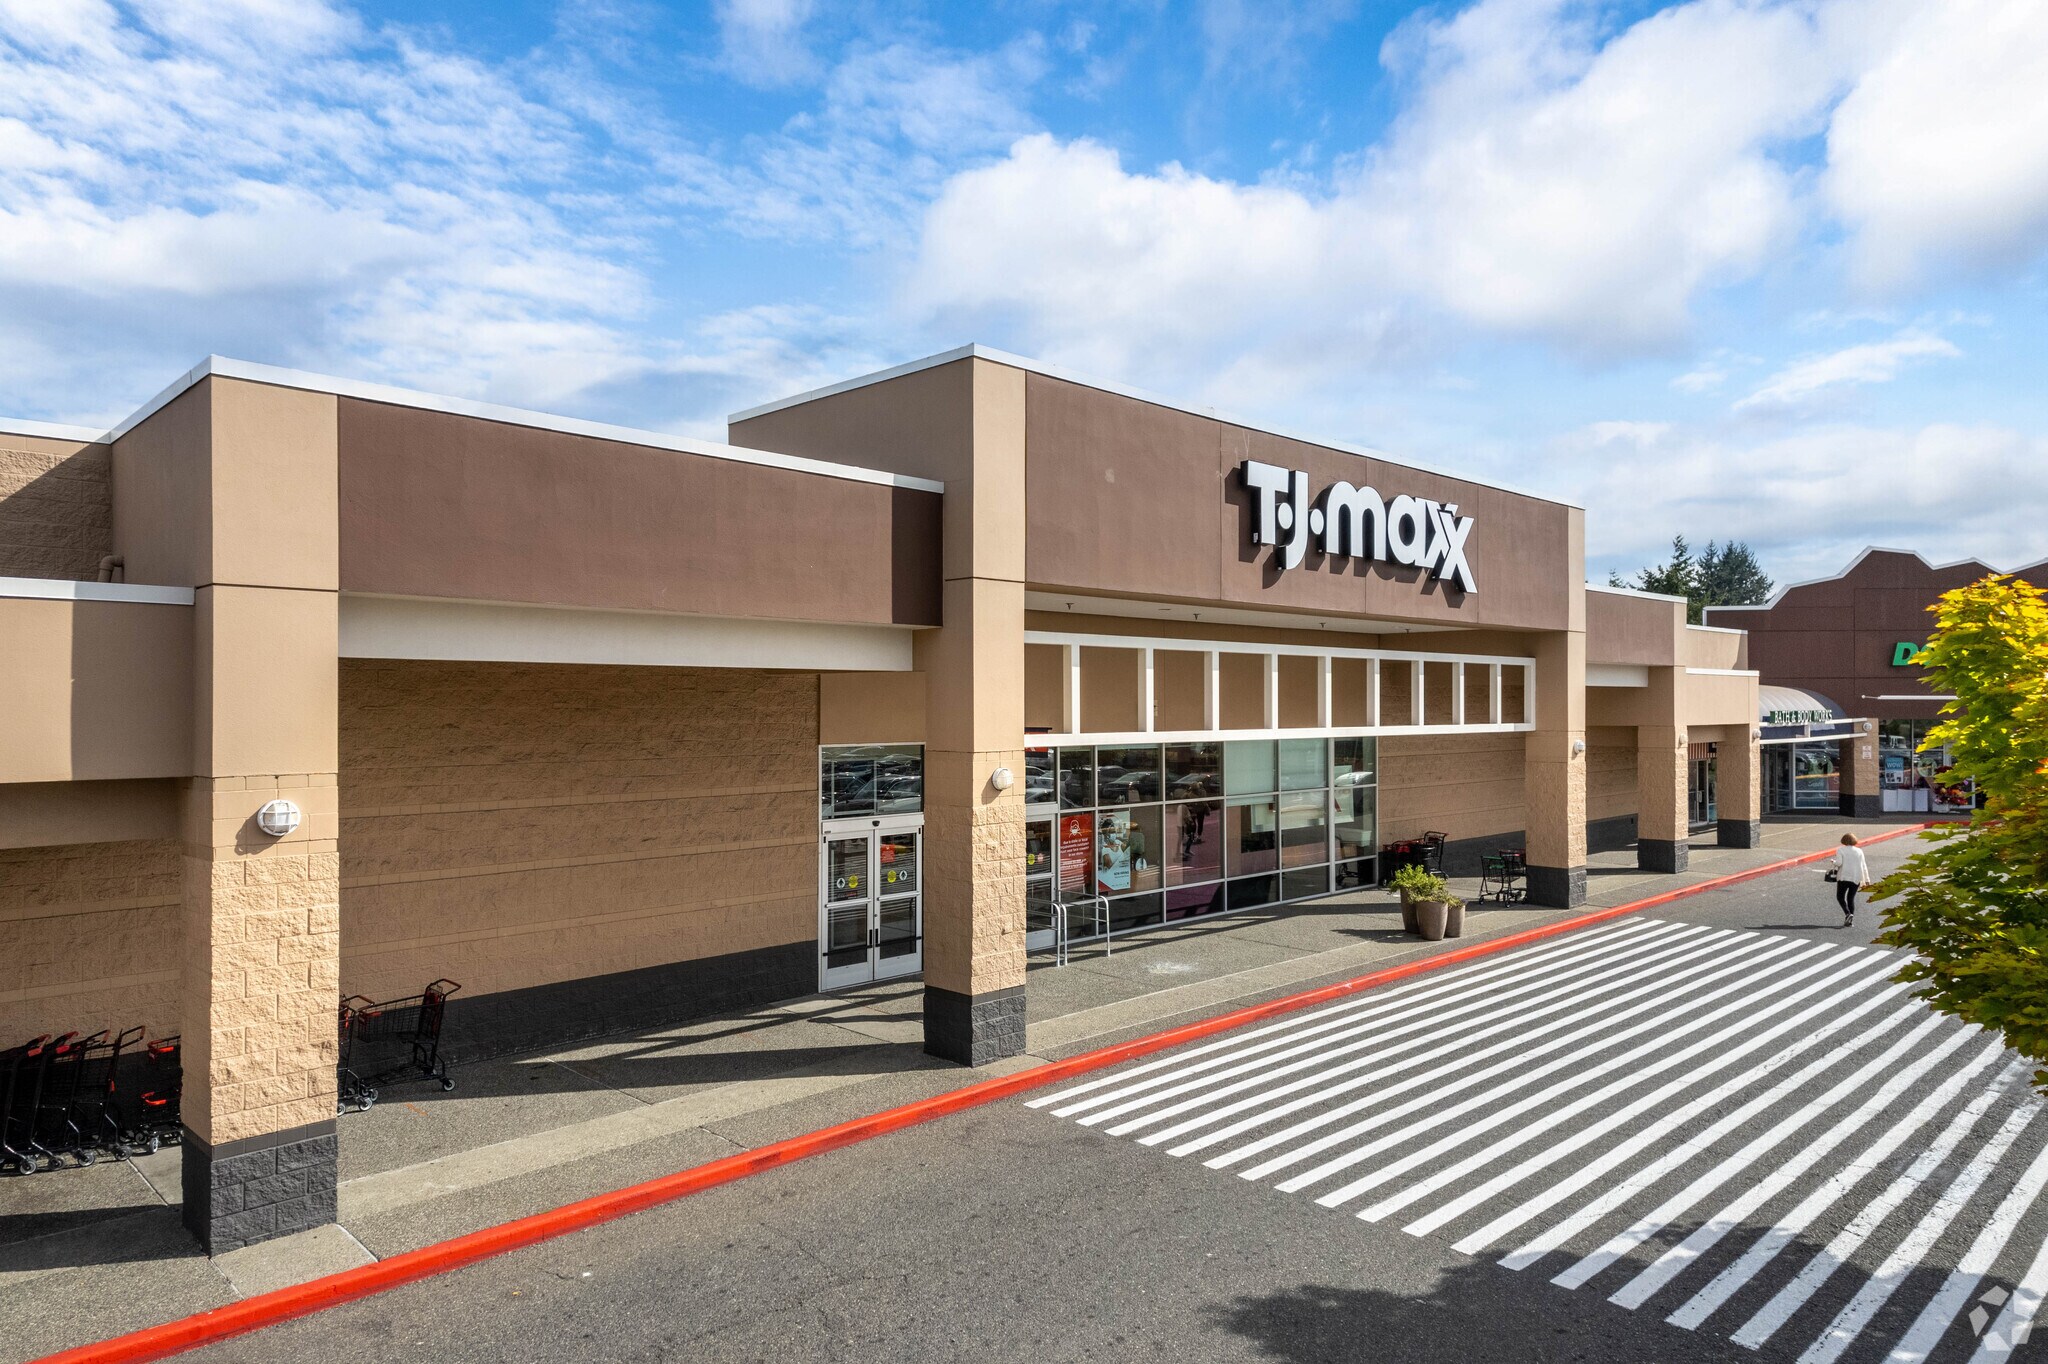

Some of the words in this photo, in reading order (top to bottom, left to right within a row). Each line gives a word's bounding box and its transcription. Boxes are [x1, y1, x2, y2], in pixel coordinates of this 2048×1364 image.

[1775, 710, 1790, 723] BATH
[1797, 710, 1812, 723] BODY
[1813, 709, 1833, 722] WORKS
